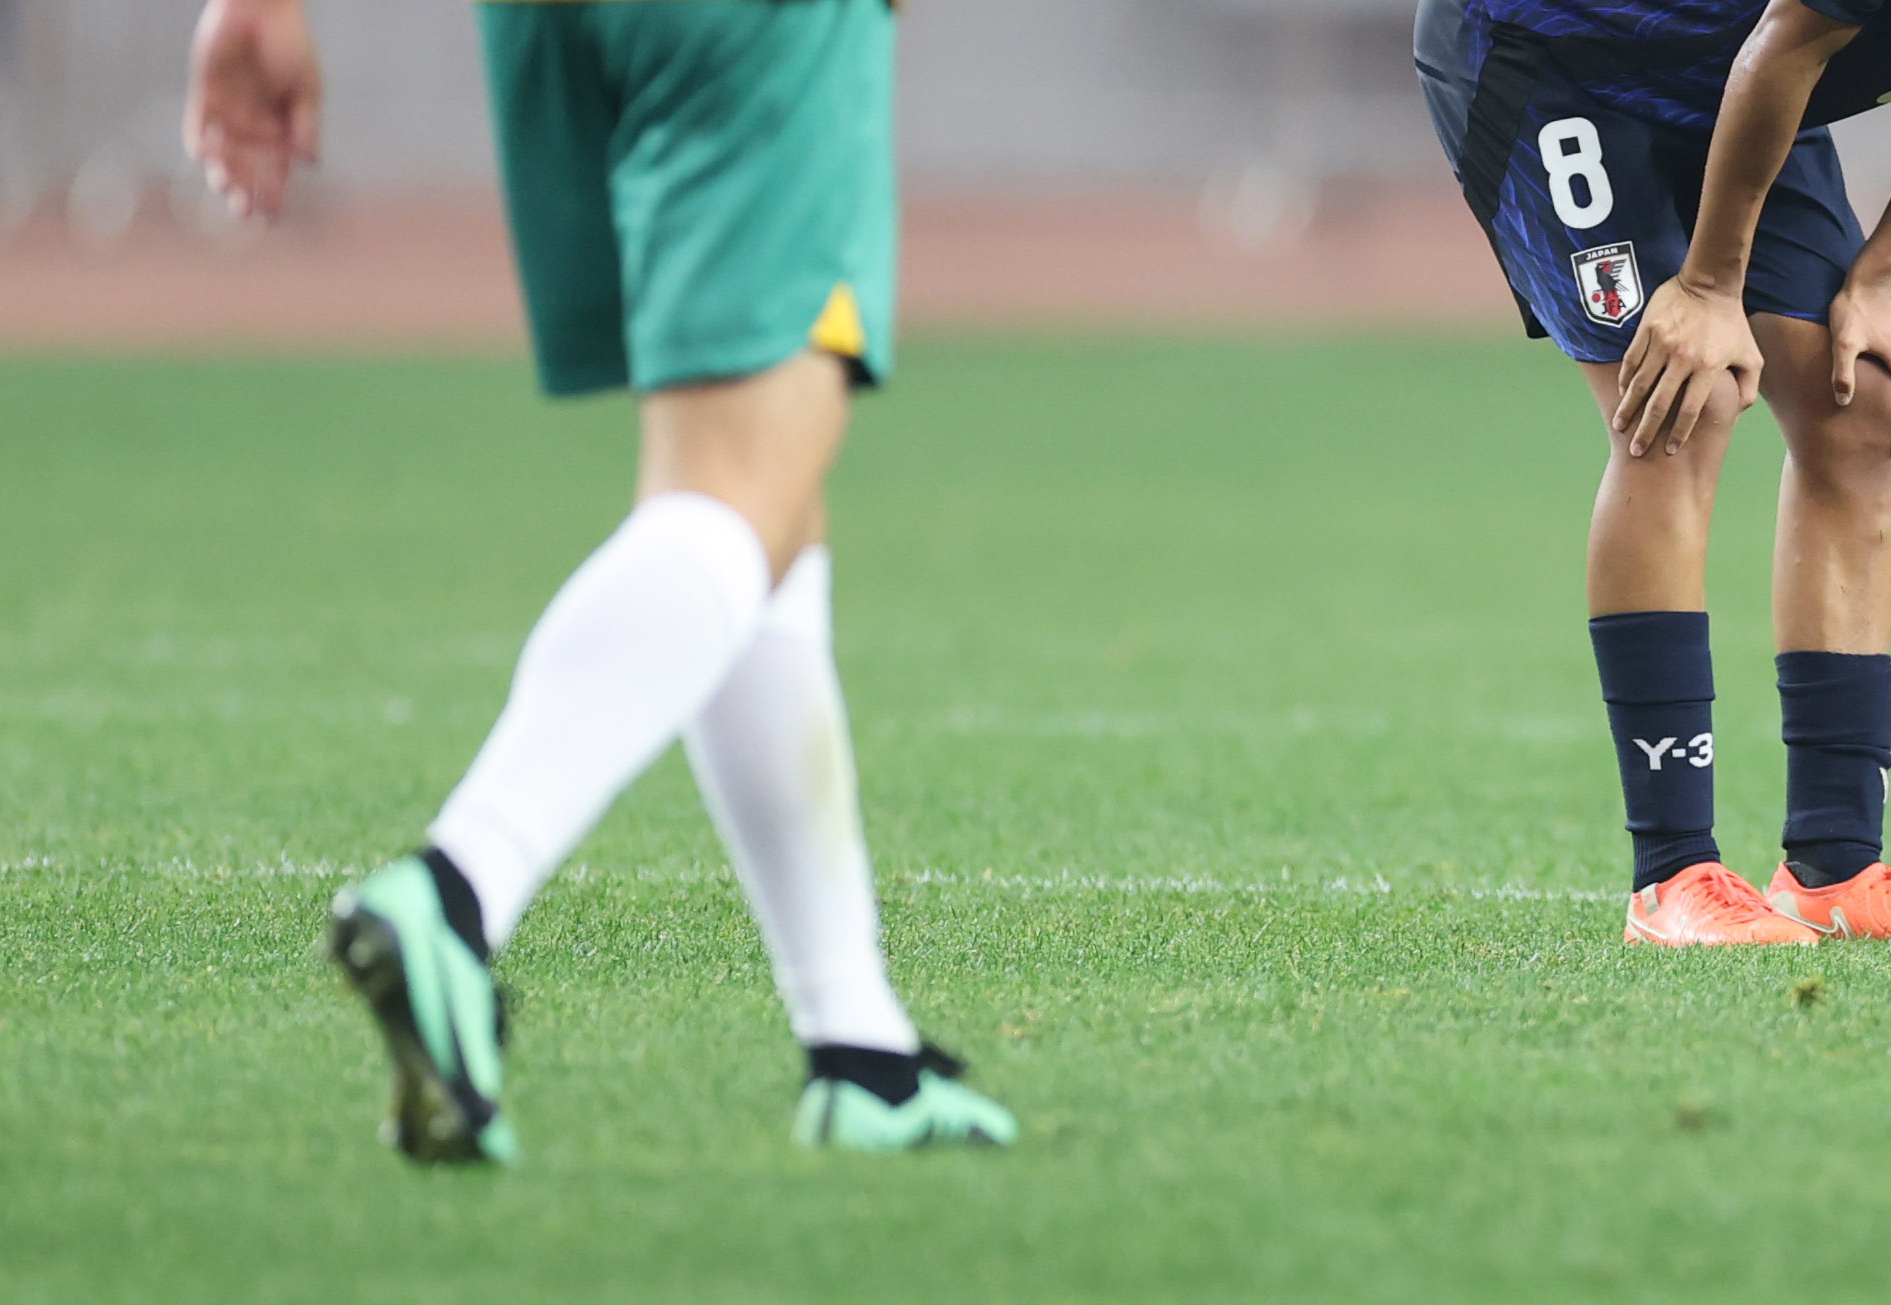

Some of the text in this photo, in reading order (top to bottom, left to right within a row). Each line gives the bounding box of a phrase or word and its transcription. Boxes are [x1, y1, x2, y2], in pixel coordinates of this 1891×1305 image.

[1538, 117, 1614, 230] 8
[1585, 247, 1619, 261] JAPAN
[1601, 297, 1627, 315] JFA
[1632, 732, 1714, 771] Y-3
